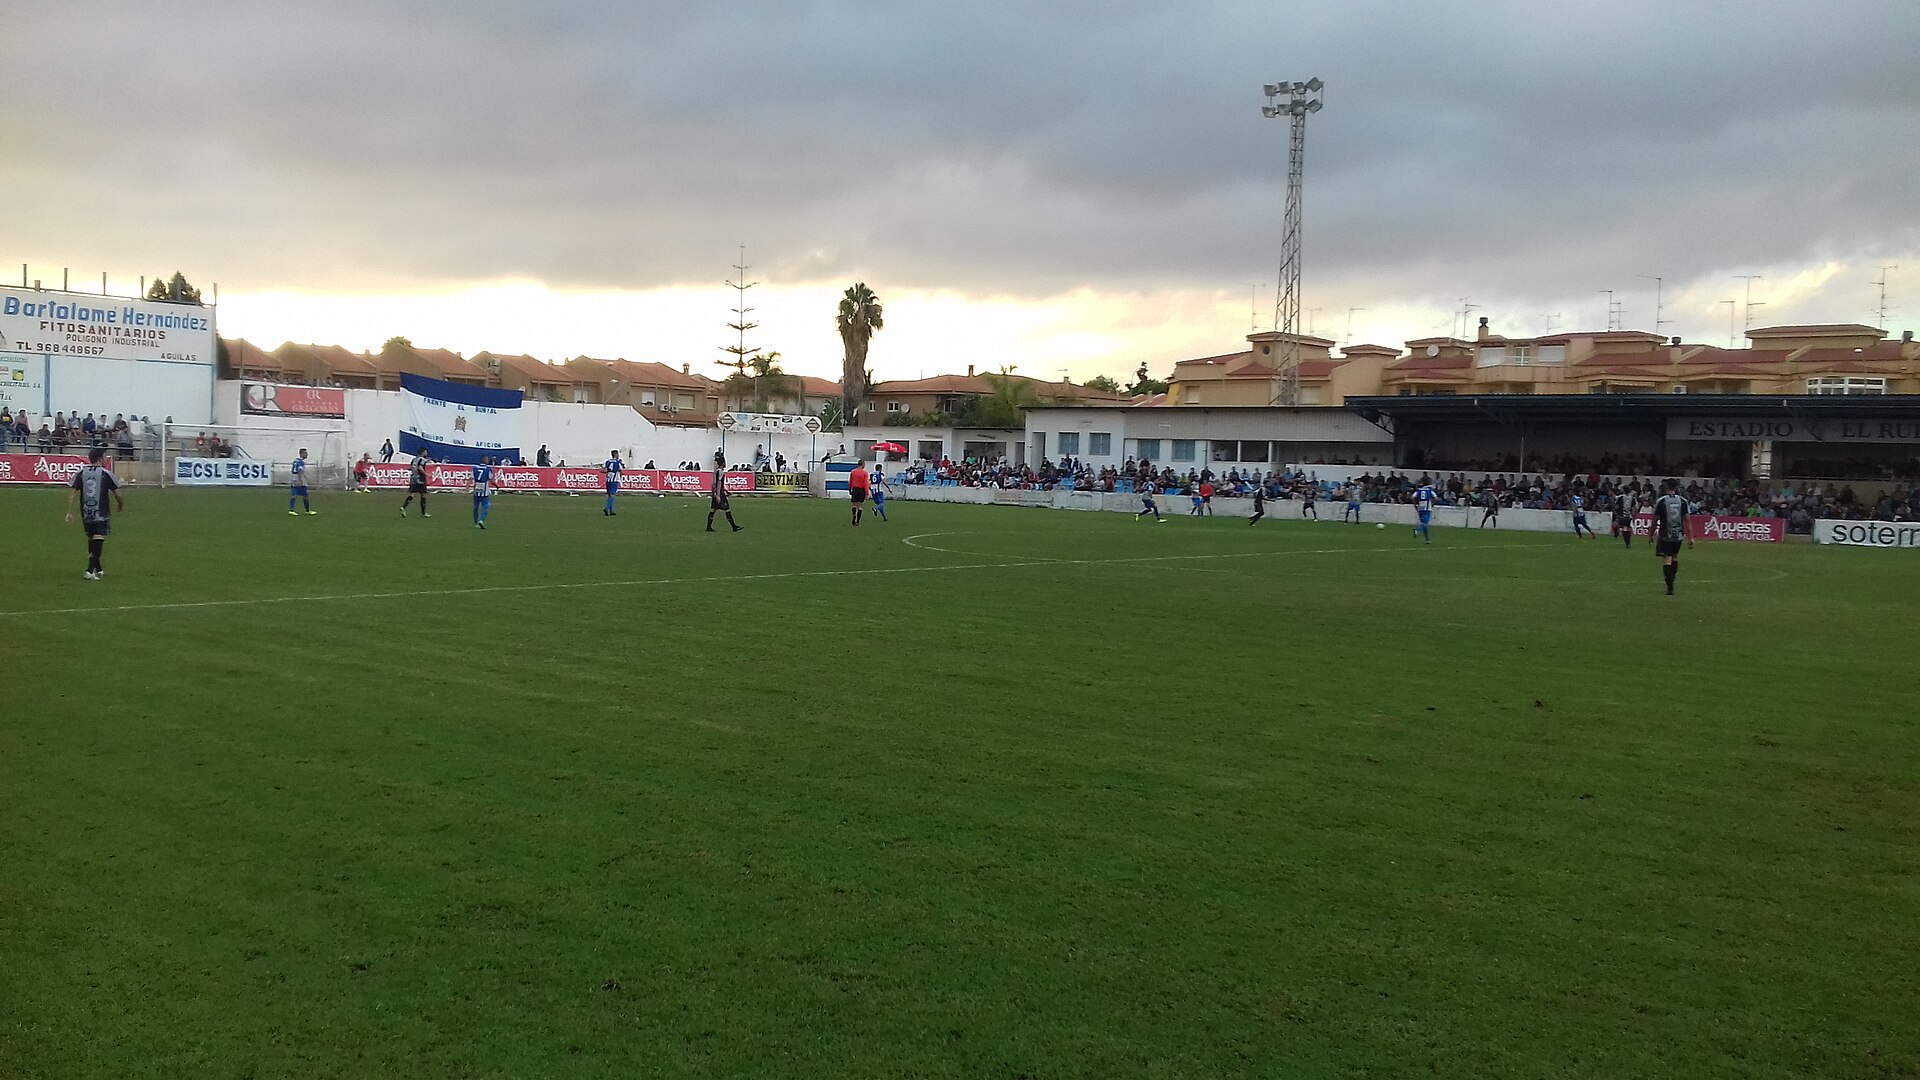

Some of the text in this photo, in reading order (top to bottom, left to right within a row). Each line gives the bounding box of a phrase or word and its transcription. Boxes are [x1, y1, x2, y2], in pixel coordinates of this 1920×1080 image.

[3, 296, 208, 331] Bartolomé Hernández
[40, 321, 166, 340] FITOSANITARIOS
[16, 341, 32, 351] TL
[112, 336, 160, 348] INDUSTRIAL
[1689, 420, 1794, 437] ESTADIO
[1841, 422, 1871, 438] EL
[34, 457, 86, 480] Apuest
[193, 463, 222, 478] CSL
[241, 464, 269, 479] CSL
[477, 469, 484, 480] 7
[608, 462, 613, 471] 4
[495, 469, 538, 487] Apuestas
[557, 470, 598, 487] Apuestas
[664, 472, 700, 489] Apuestas
[872, 474, 878, 483] 6
[1704, 516, 1772, 539] Apuestas
[1722, 532, 1771, 541] de Murcia
